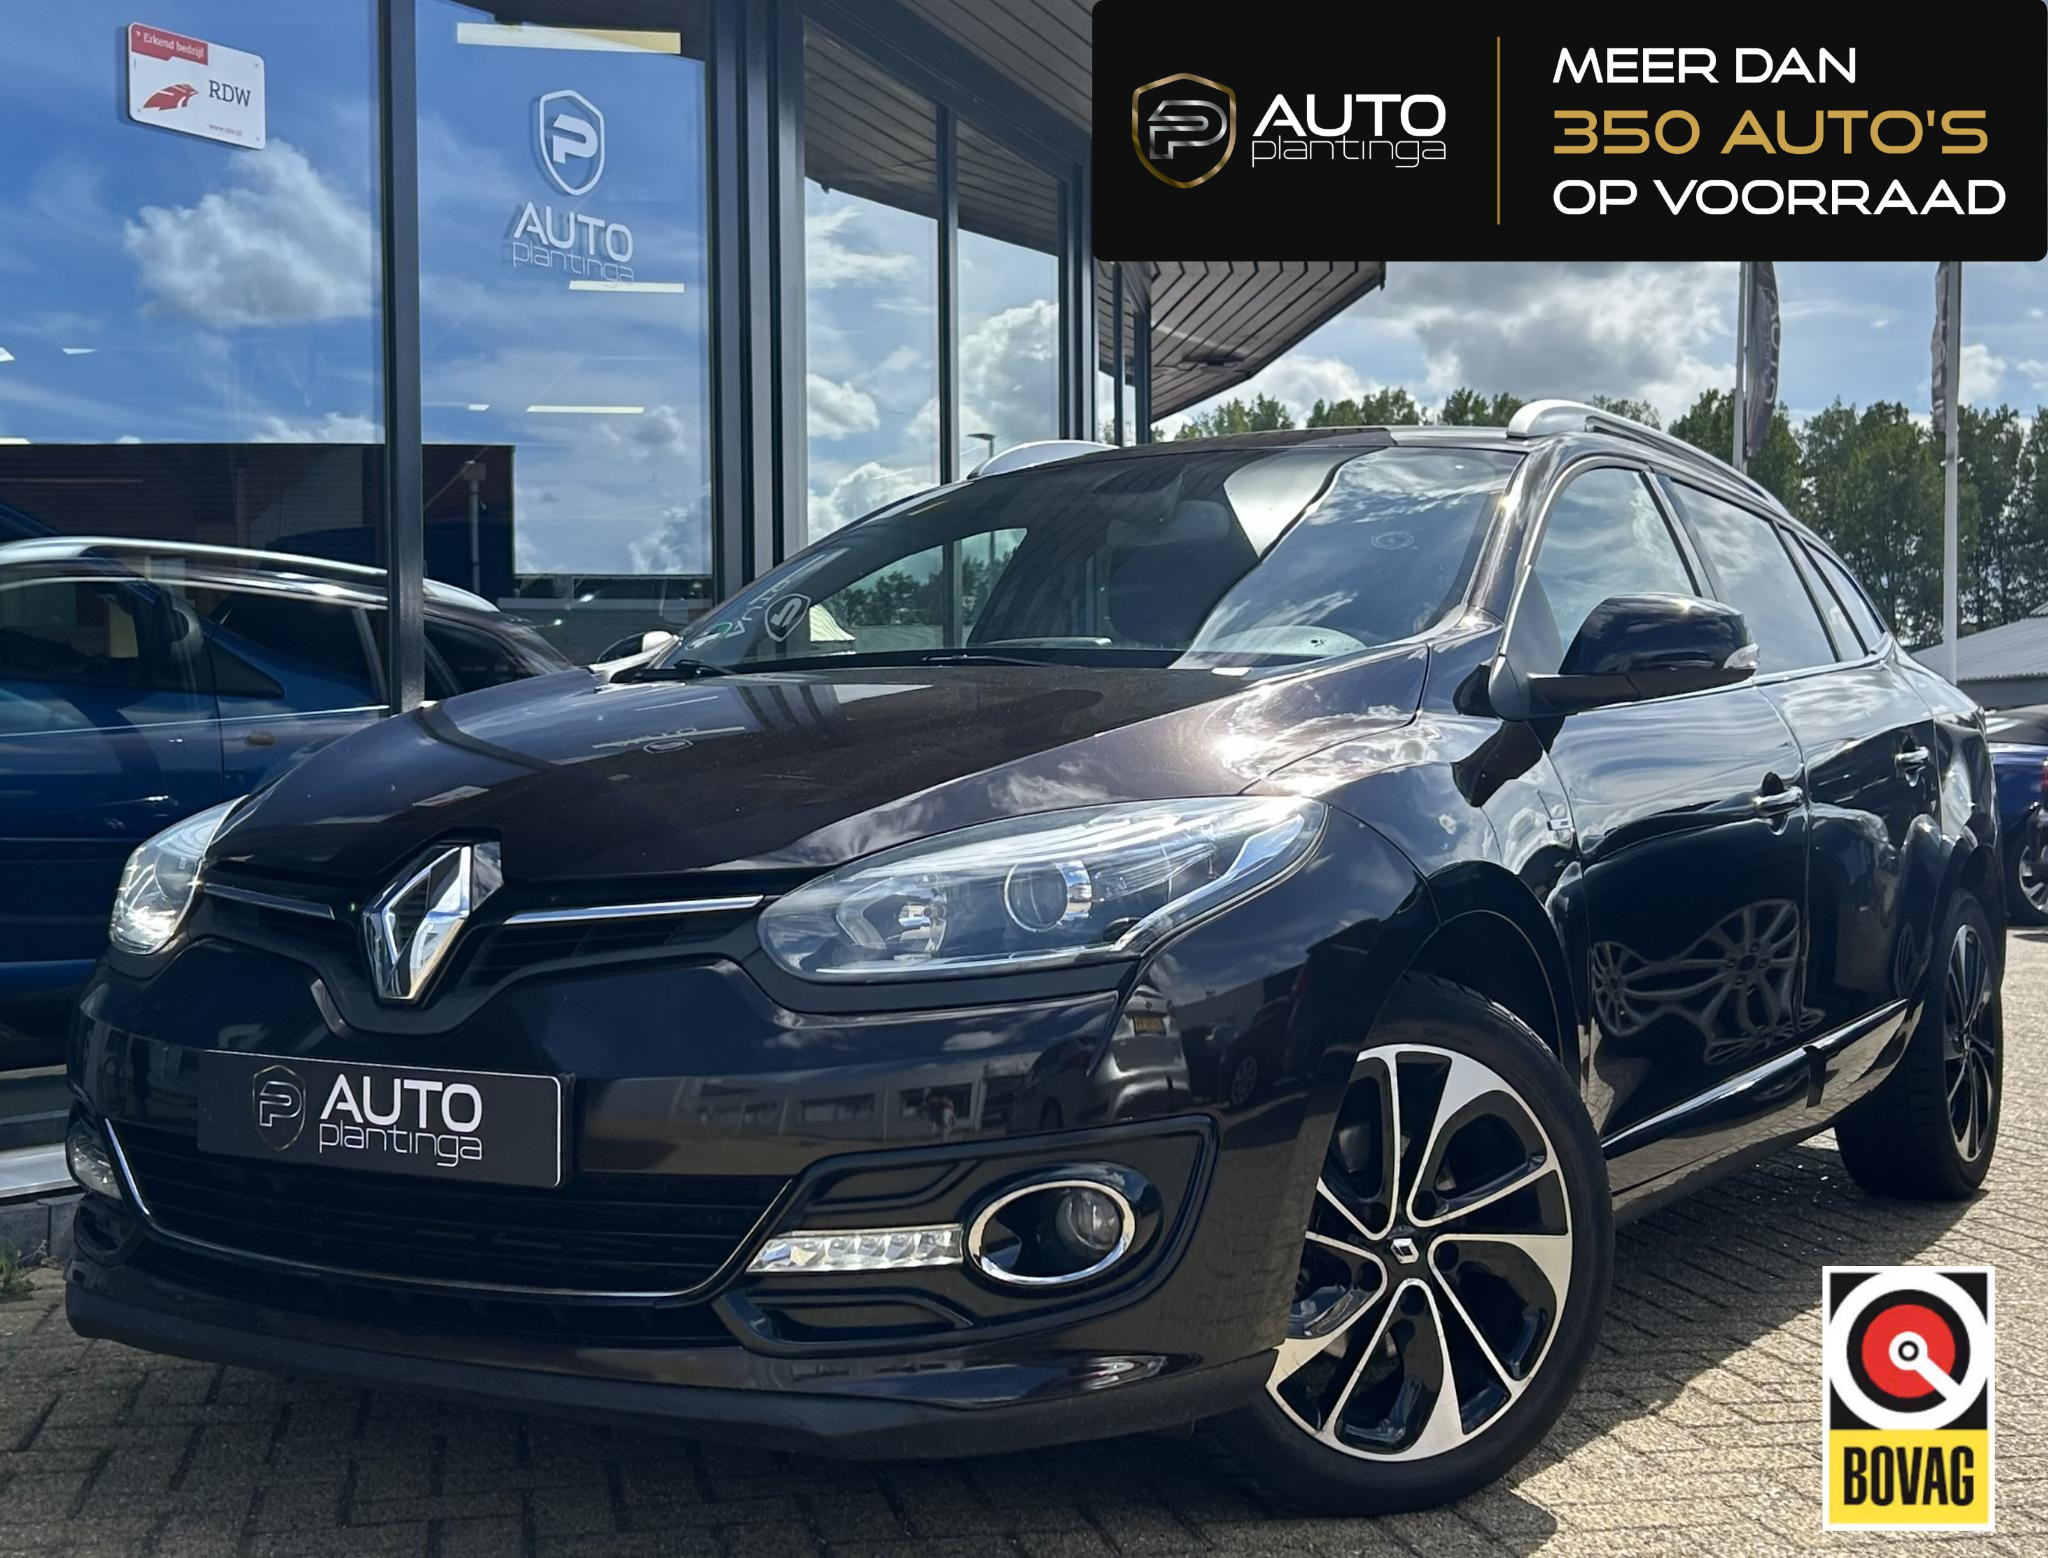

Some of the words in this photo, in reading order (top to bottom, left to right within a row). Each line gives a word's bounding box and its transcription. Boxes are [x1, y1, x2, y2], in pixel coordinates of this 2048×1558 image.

[208, 79, 251, 107] RDW
[513, 201, 634, 263] AUTO
[512, 240, 635, 286] plantinga
[319, 1073, 483, 1133] AUTO
[319, 1120, 483, 1167] plantinga
